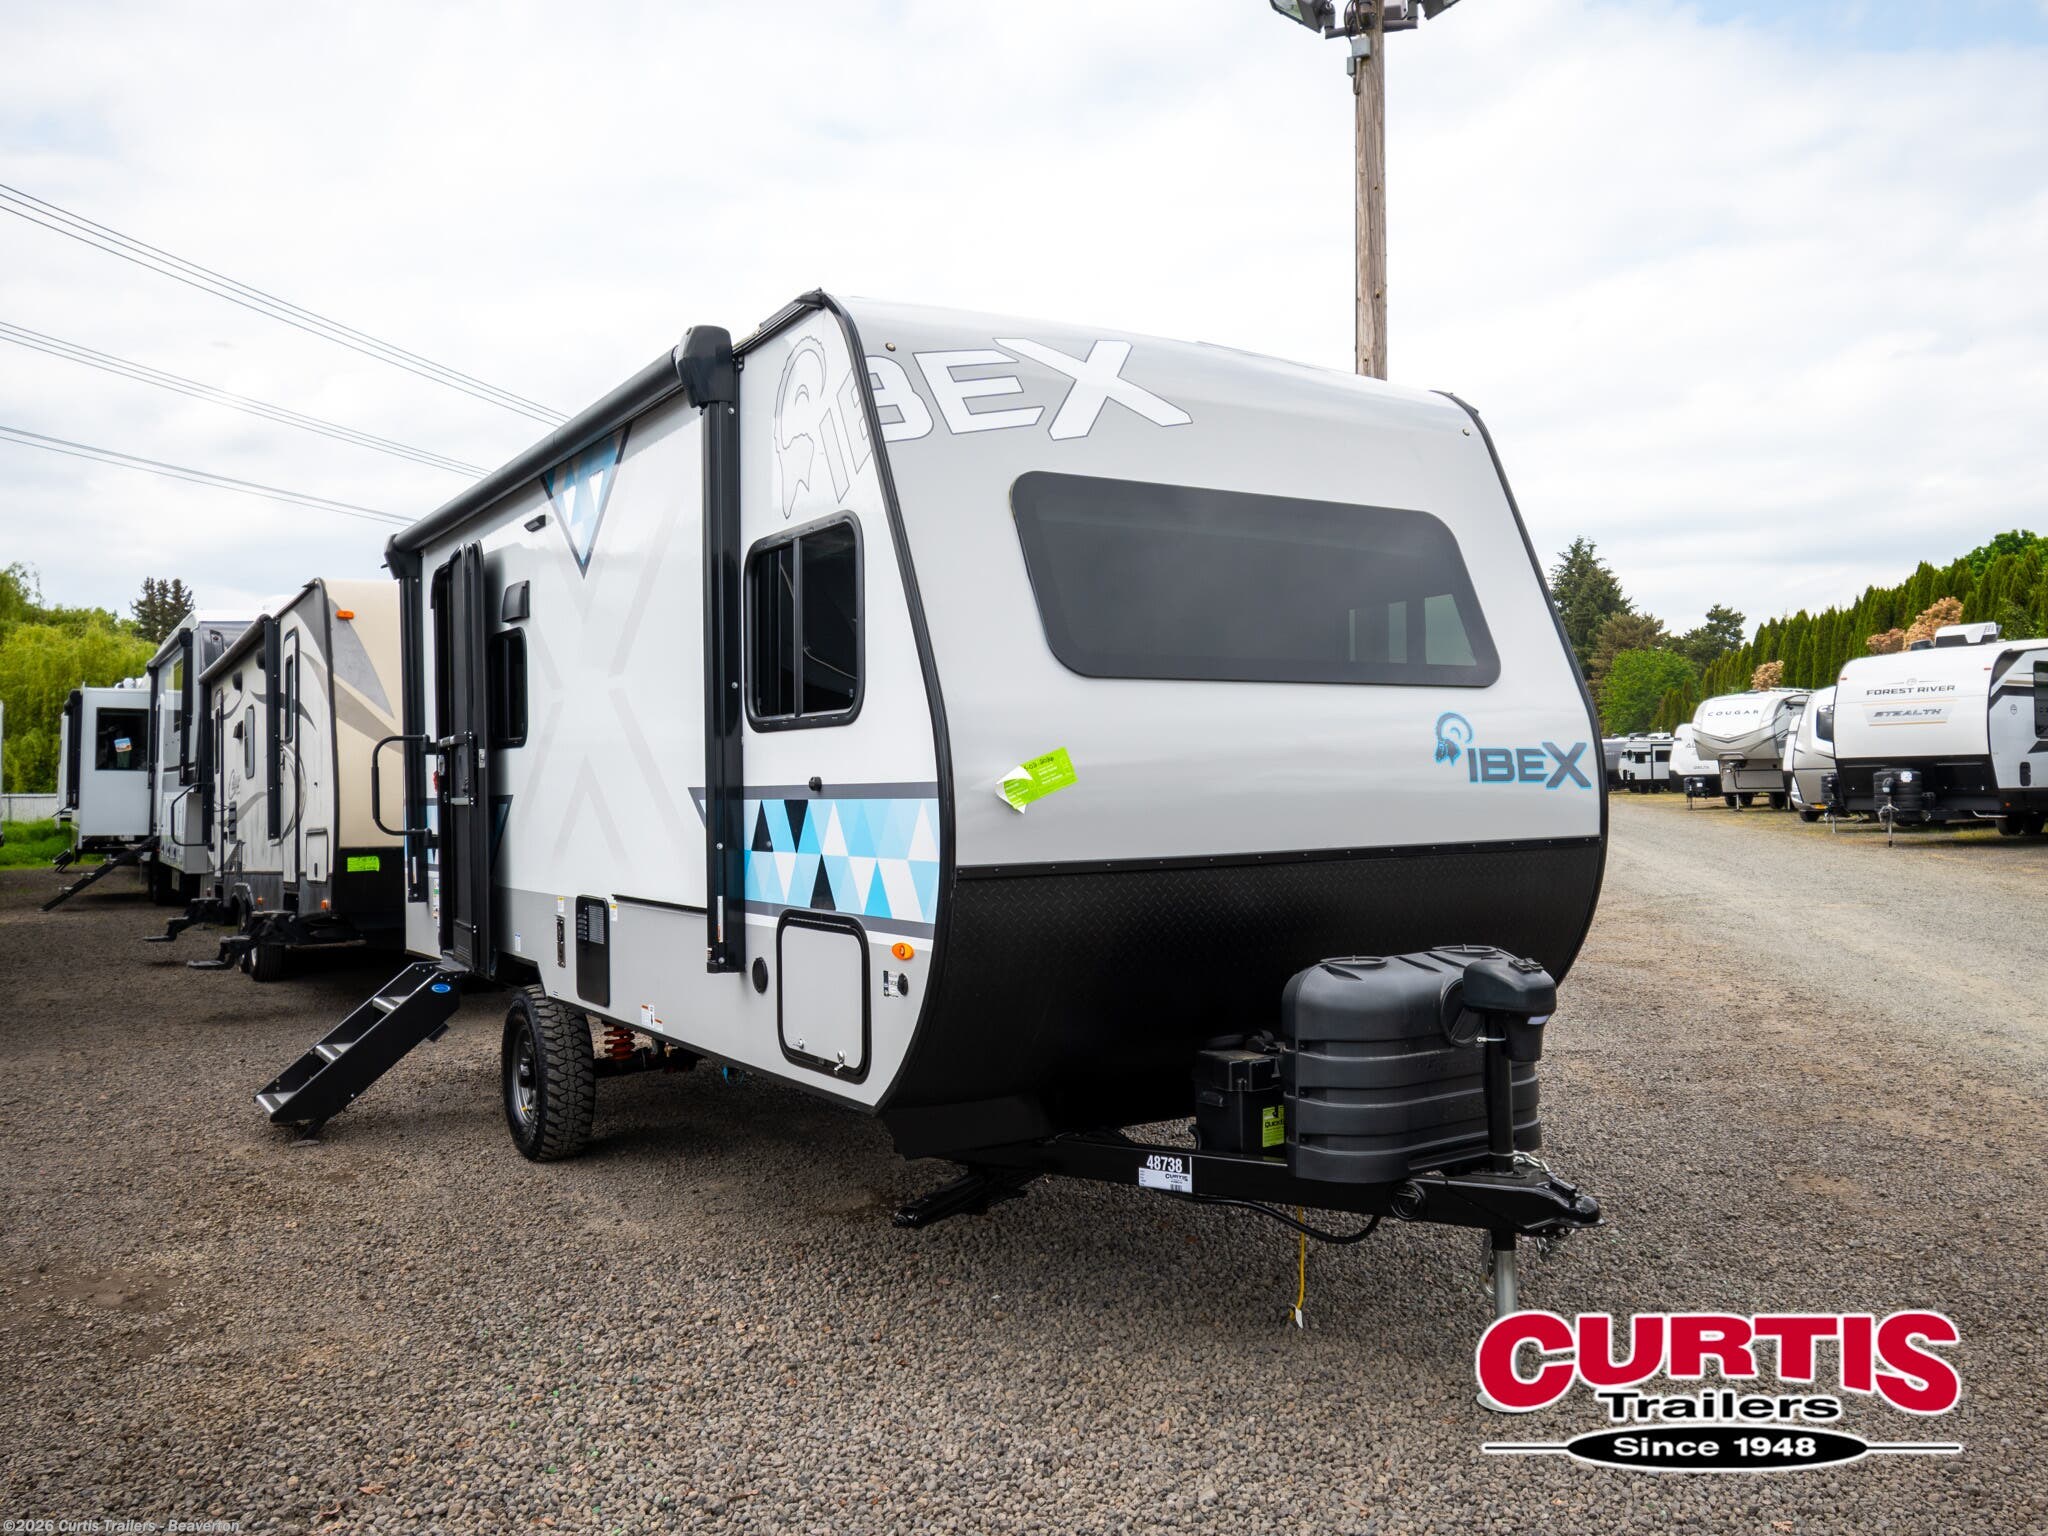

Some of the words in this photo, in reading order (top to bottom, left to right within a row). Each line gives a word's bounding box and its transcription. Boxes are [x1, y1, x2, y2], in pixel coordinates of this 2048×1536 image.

[819, 338, 1193, 504] IBEX
[1866, 687, 1914, 696] FOREST
[1917, 684, 1955, 694] RIVER
[1707, 709, 1759, 717] COUGAR
[1873, 708, 1942, 718] STEALTH
[1467, 742, 1592, 789] IBEX
[1146, 1154, 1183, 1173] 48738
